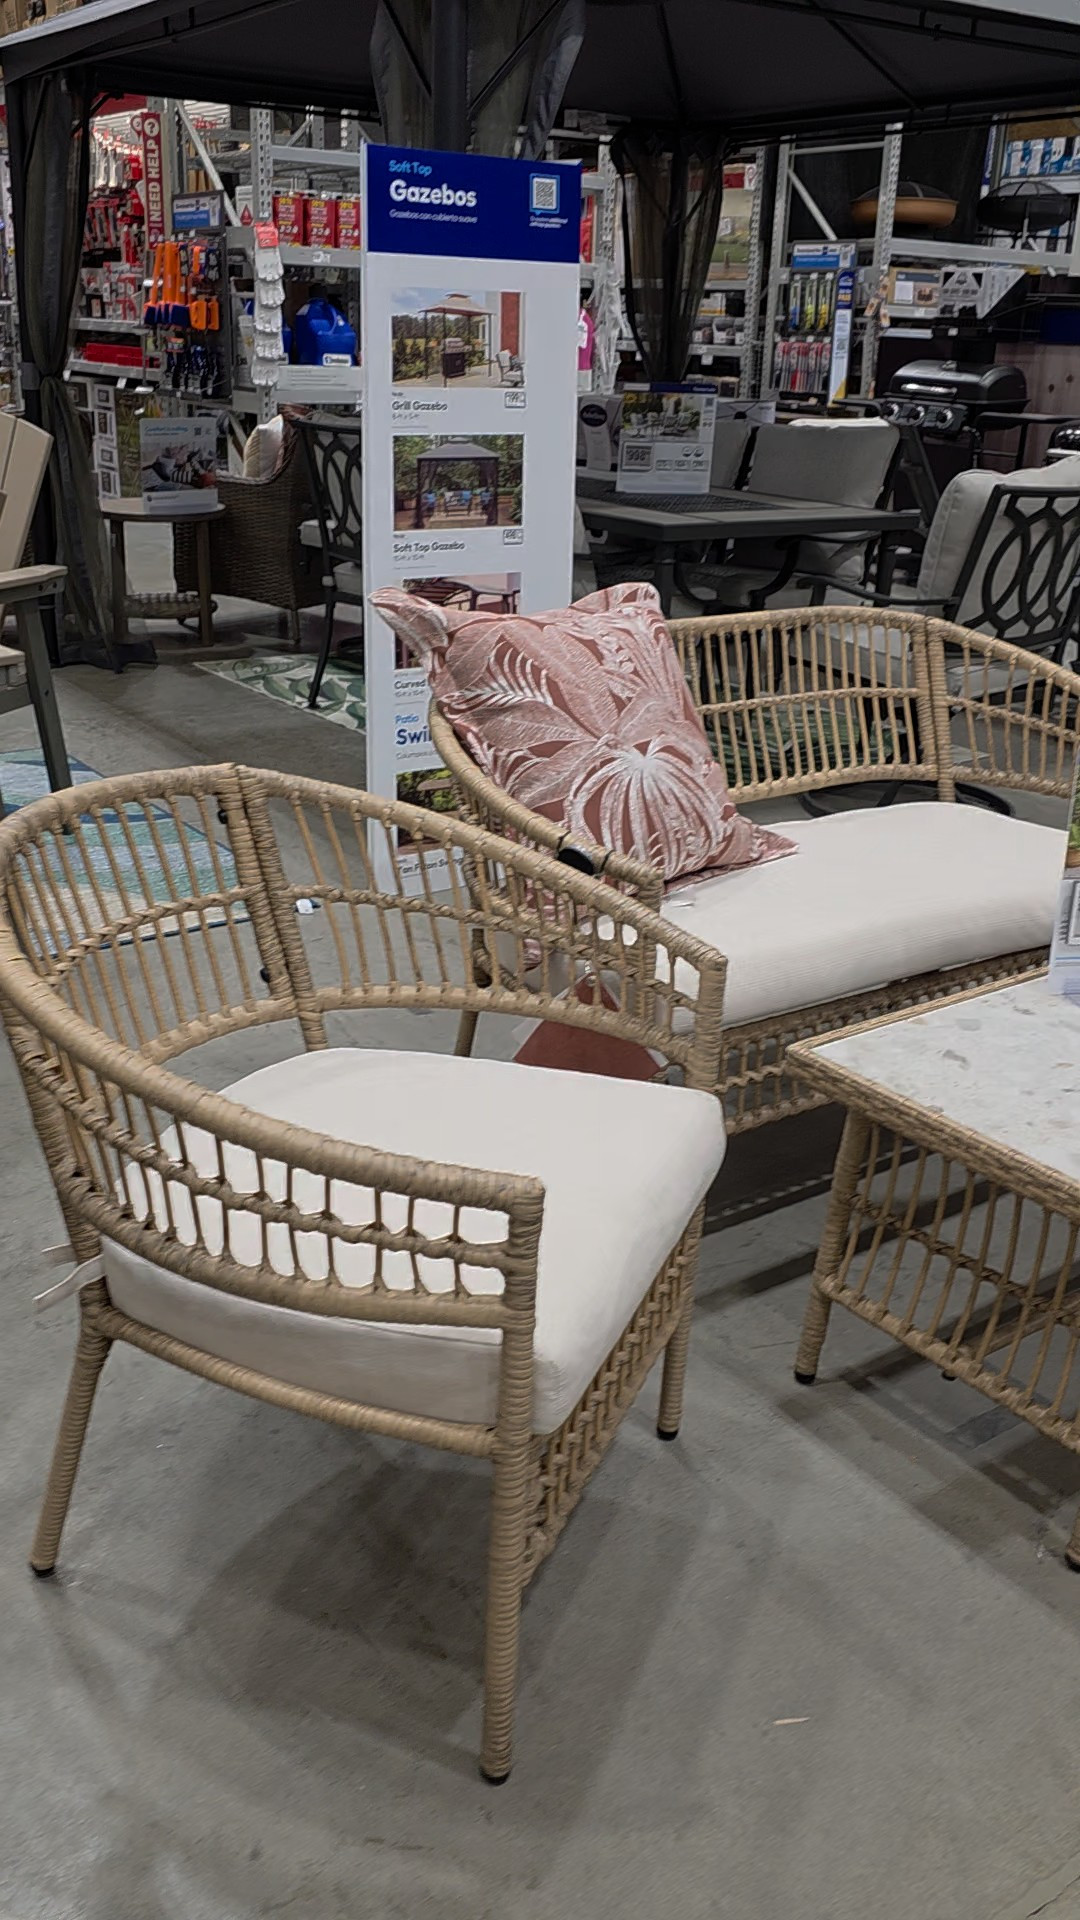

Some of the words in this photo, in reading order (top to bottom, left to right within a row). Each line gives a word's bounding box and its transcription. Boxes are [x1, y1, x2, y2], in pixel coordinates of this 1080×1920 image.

[146, 139, 160, 178] HELP
[388, 160, 411, 173] Soft
[412, 161, 433, 177] Top
[148, 181, 161, 220] NEED
[389, 179, 477, 208] Gazebos
[391, 400, 411, 411] Grill
[412, 400, 448, 411] Gazebo
[393, 543, 412, 553] Soft
[414, 542, 430, 554] Top
[431, 541, 465, 551] Gazebo
[394, 679, 426, 689] Curved
[395, 714, 419, 723] Patio
